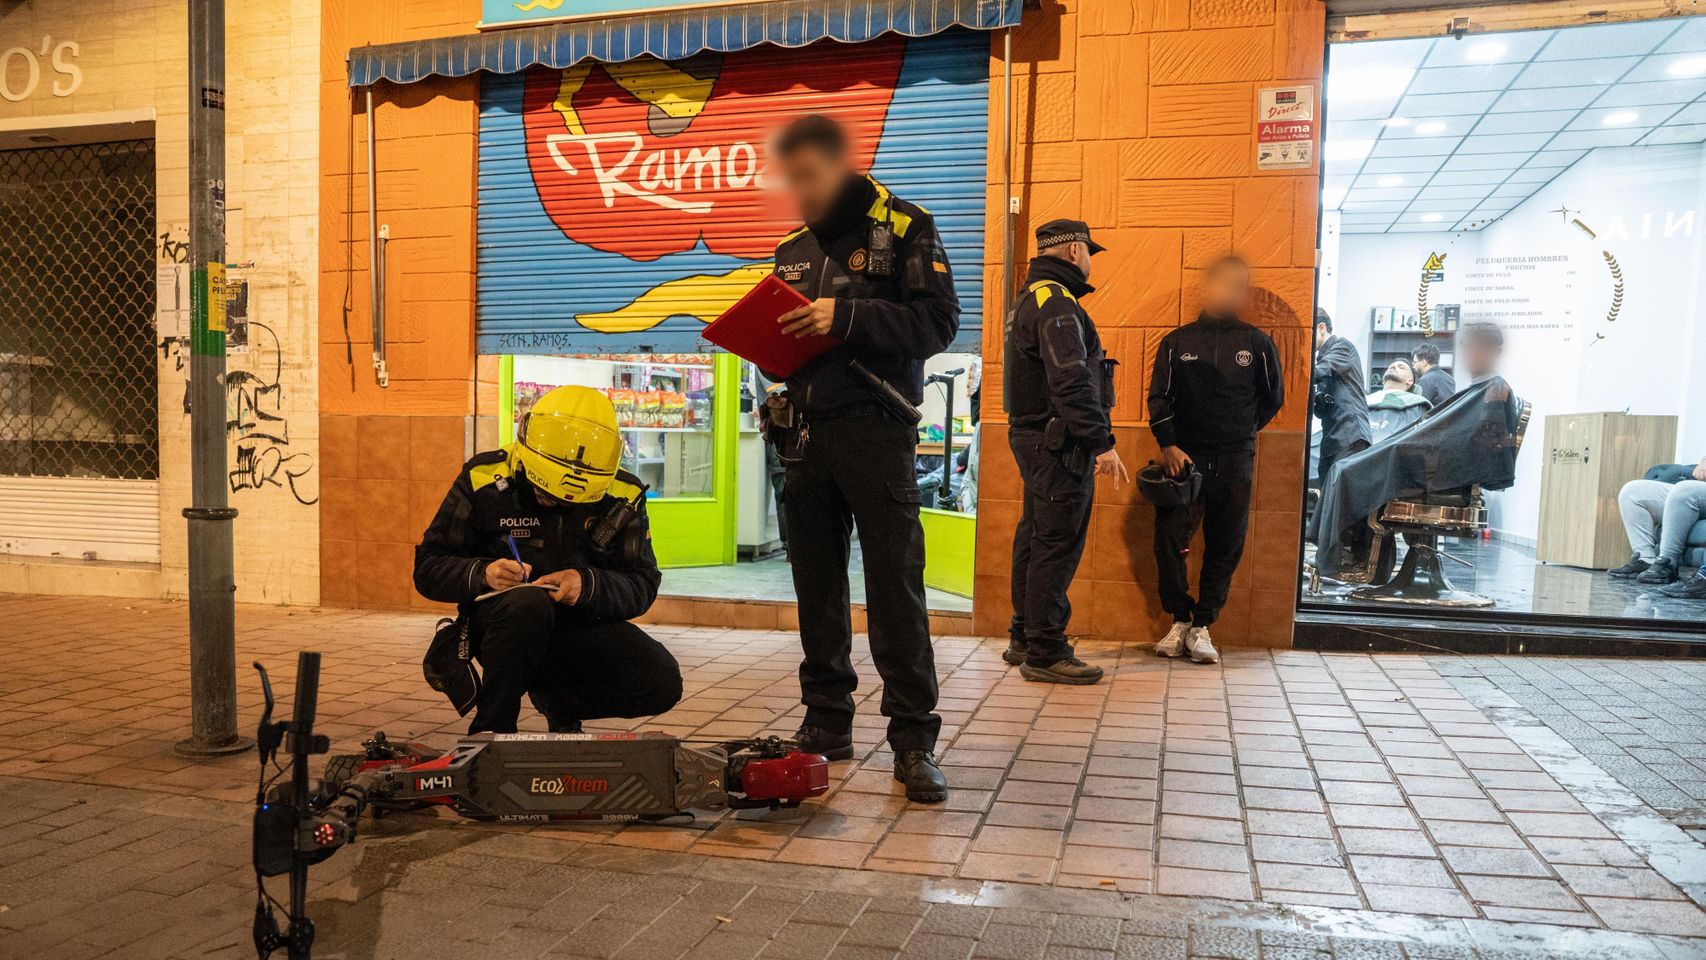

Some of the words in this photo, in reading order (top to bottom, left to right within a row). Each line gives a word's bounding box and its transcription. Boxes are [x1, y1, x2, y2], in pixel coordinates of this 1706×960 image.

[1262, 124, 1310, 134] Alarma
[546, 132, 768, 214] Ramo
[1528, 255, 1569, 263] HOMBRES
[527, 469, 550, 489] POLICIA
[499, 517, 541, 527] POLICIA
[494, 733, 547, 741] ULTIMATE
[420, 775, 453, 791] M41
[499, 814, 549, 822] ULTIMATE
